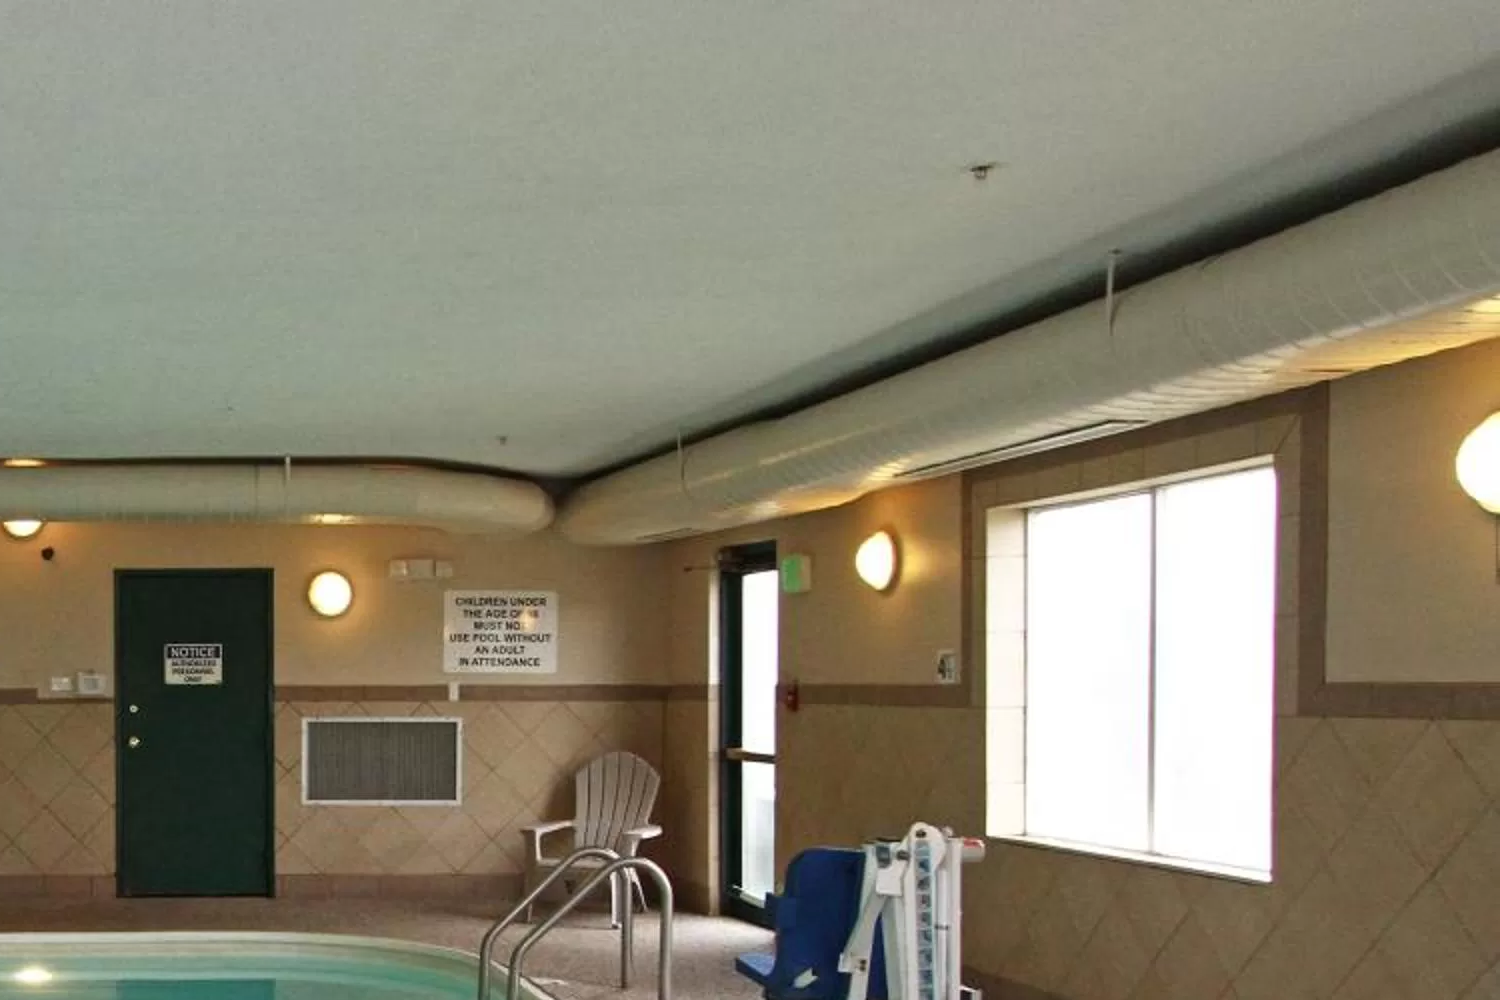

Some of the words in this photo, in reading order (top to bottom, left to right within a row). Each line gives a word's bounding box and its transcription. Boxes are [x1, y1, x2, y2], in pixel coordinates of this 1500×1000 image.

[455, 597, 507, 606] CHILDREN
[510, 597, 547, 606] UNDER
[463, 609, 482, 618] THE
[486, 609, 507, 618] AGE
[474, 622, 501, 630] MUST
[450, 634, 469, 643] USE
[473, 634, 500, 643] POOL
[504, 634, 550, 643] WITHOUT
[171, 647, 215, 657] NOTICE
[474, 646, 488, 655] AN
[492, 646, 525, 655] ADULT
[460, 658, 469, 667] IN
[472, 658, 540, 667] ATTENDANCE
